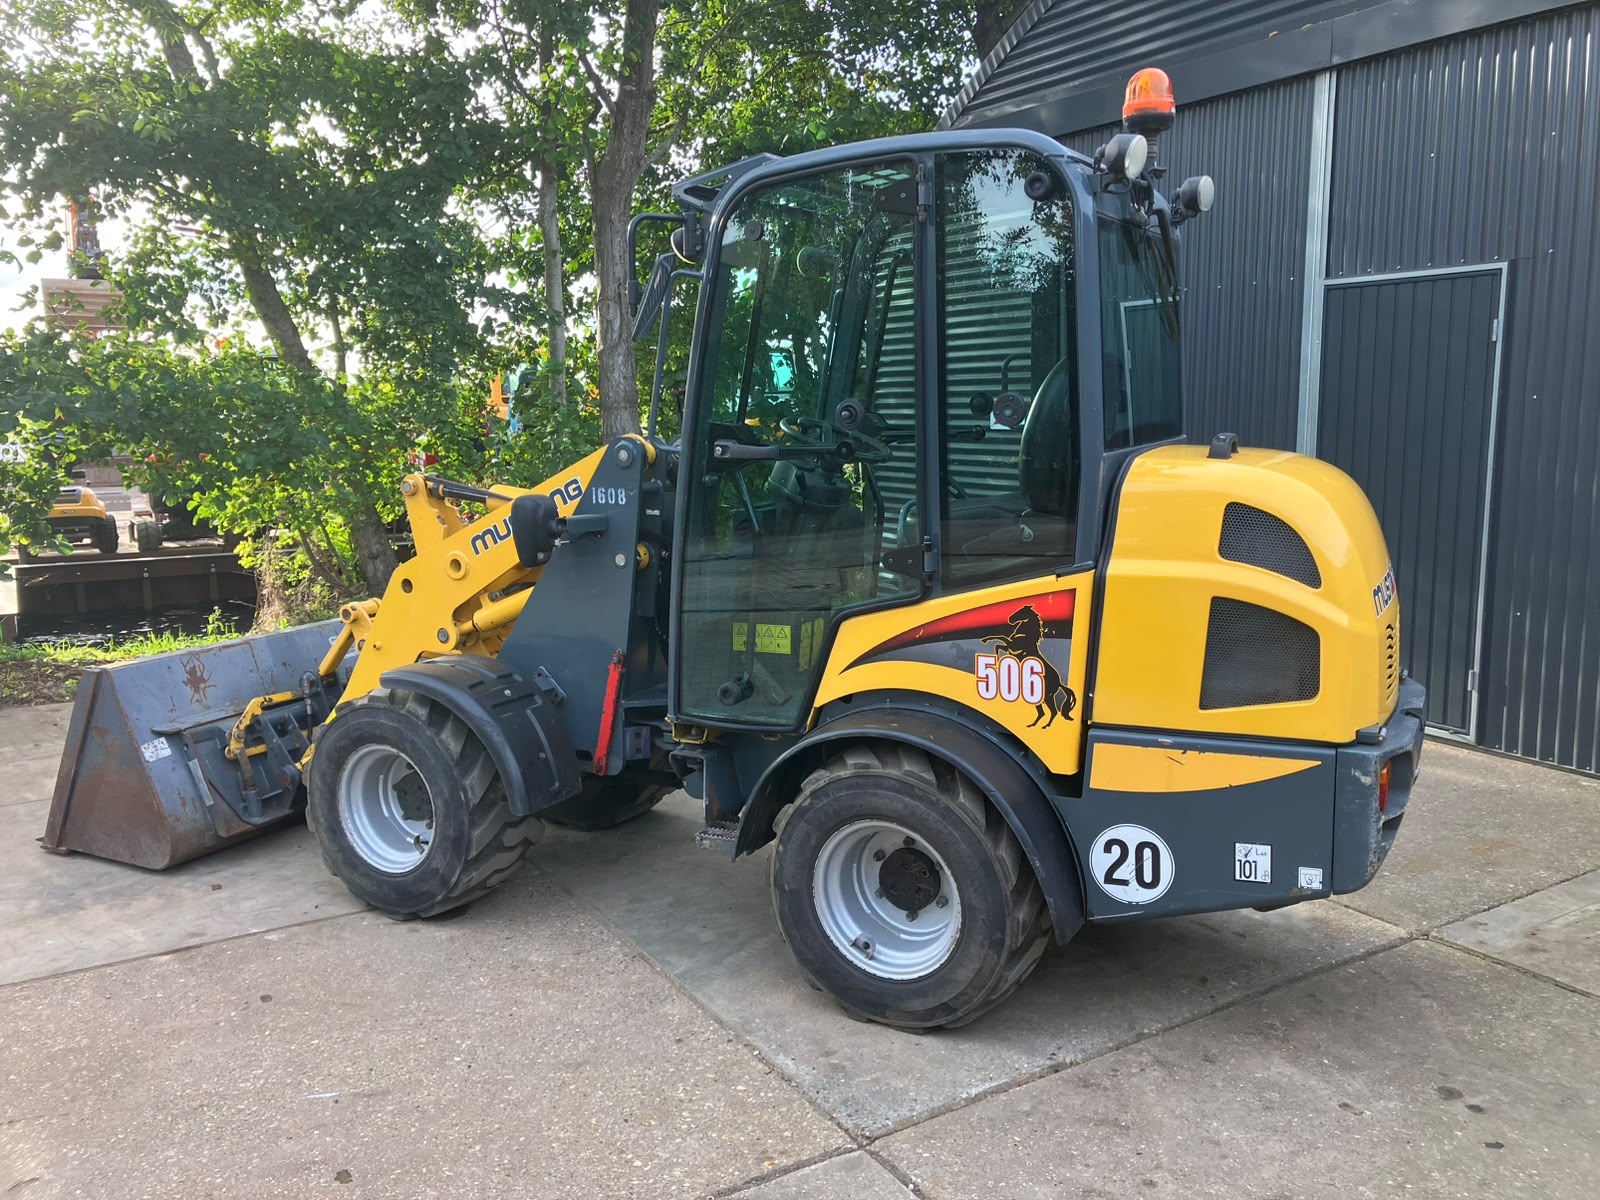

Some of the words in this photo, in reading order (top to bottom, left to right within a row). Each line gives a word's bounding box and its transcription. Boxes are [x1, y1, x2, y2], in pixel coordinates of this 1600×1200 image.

[591, 486, 627, 505] 1608
[975, 654, 1045, 706] 506
[1103, 838, 1161, 890] 20
[1237, 859, 1257, 880] 101
